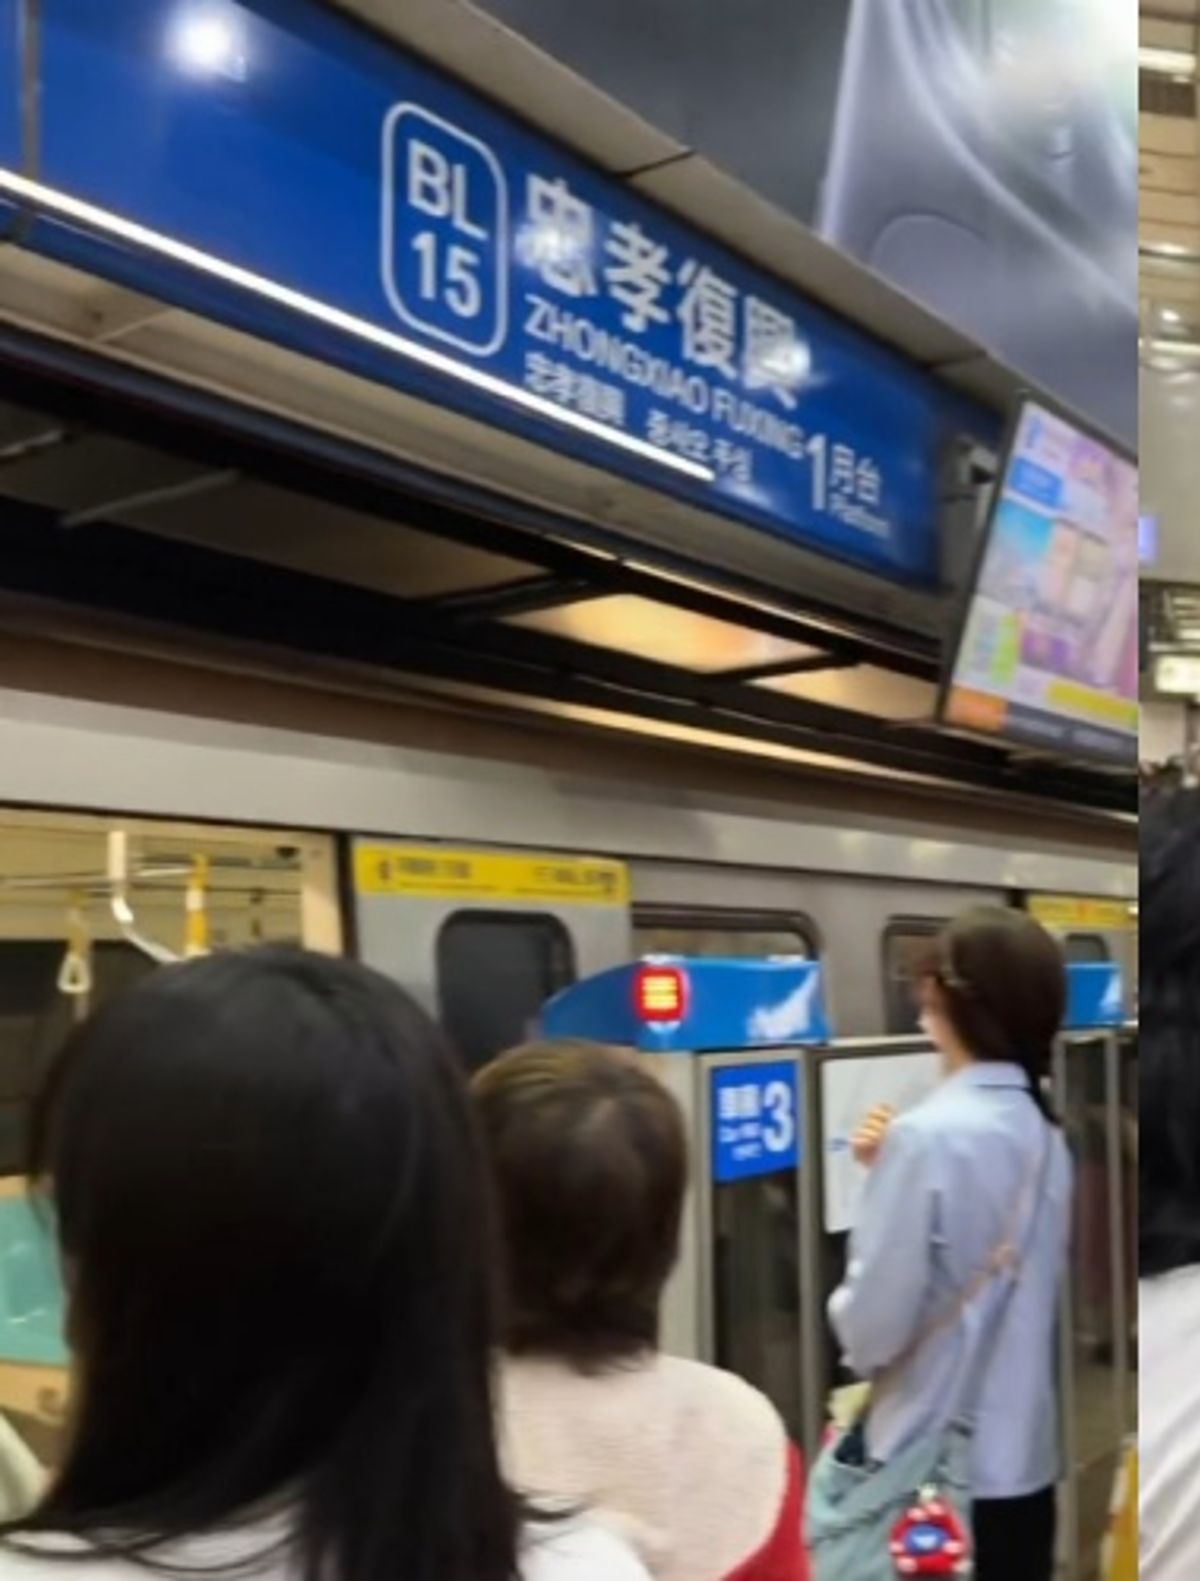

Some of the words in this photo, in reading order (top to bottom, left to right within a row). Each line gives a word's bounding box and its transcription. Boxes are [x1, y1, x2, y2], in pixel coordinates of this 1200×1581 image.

[408, 139, 486, 240] BL
[411, 233, 482, 318] 15
[524, 293, 709, 413] ZHONGXIAO
[807, 433, 827, 511] 1
[830, 443, 882, 505] 月台
[763, 1080, 794, 1152] 3
